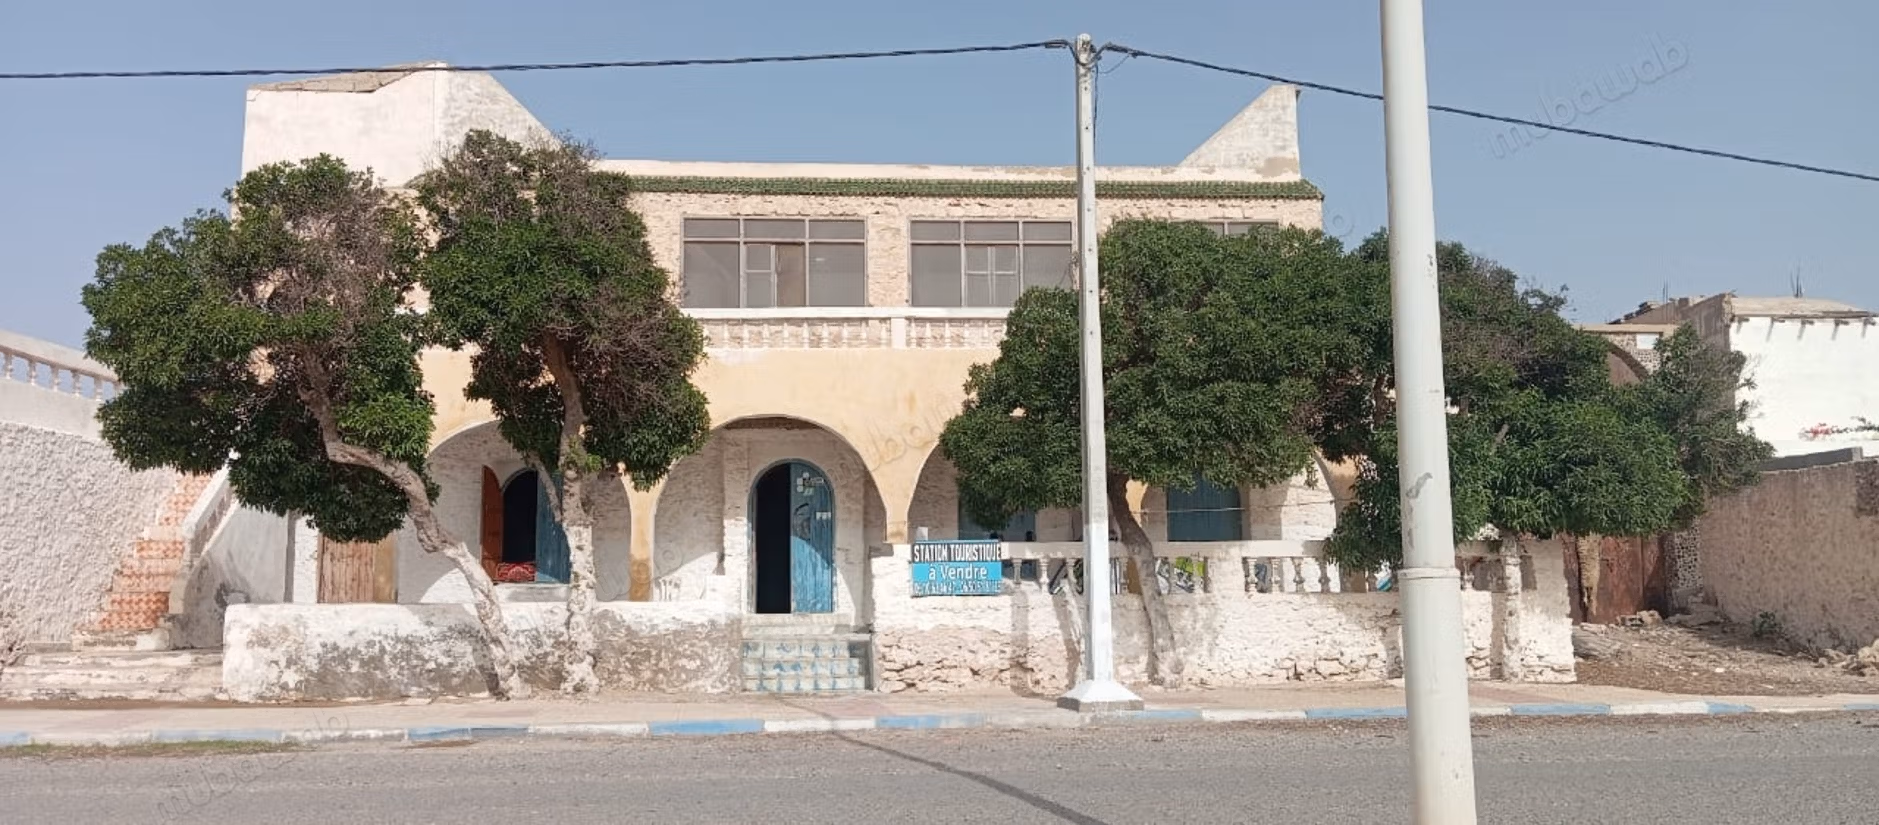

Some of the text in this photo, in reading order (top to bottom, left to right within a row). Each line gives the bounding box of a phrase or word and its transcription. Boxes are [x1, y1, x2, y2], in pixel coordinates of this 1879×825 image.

[914, 543, 1001, 563] STATION TOURISTIQUE
[928, 563, 987, 580] à Vendre
